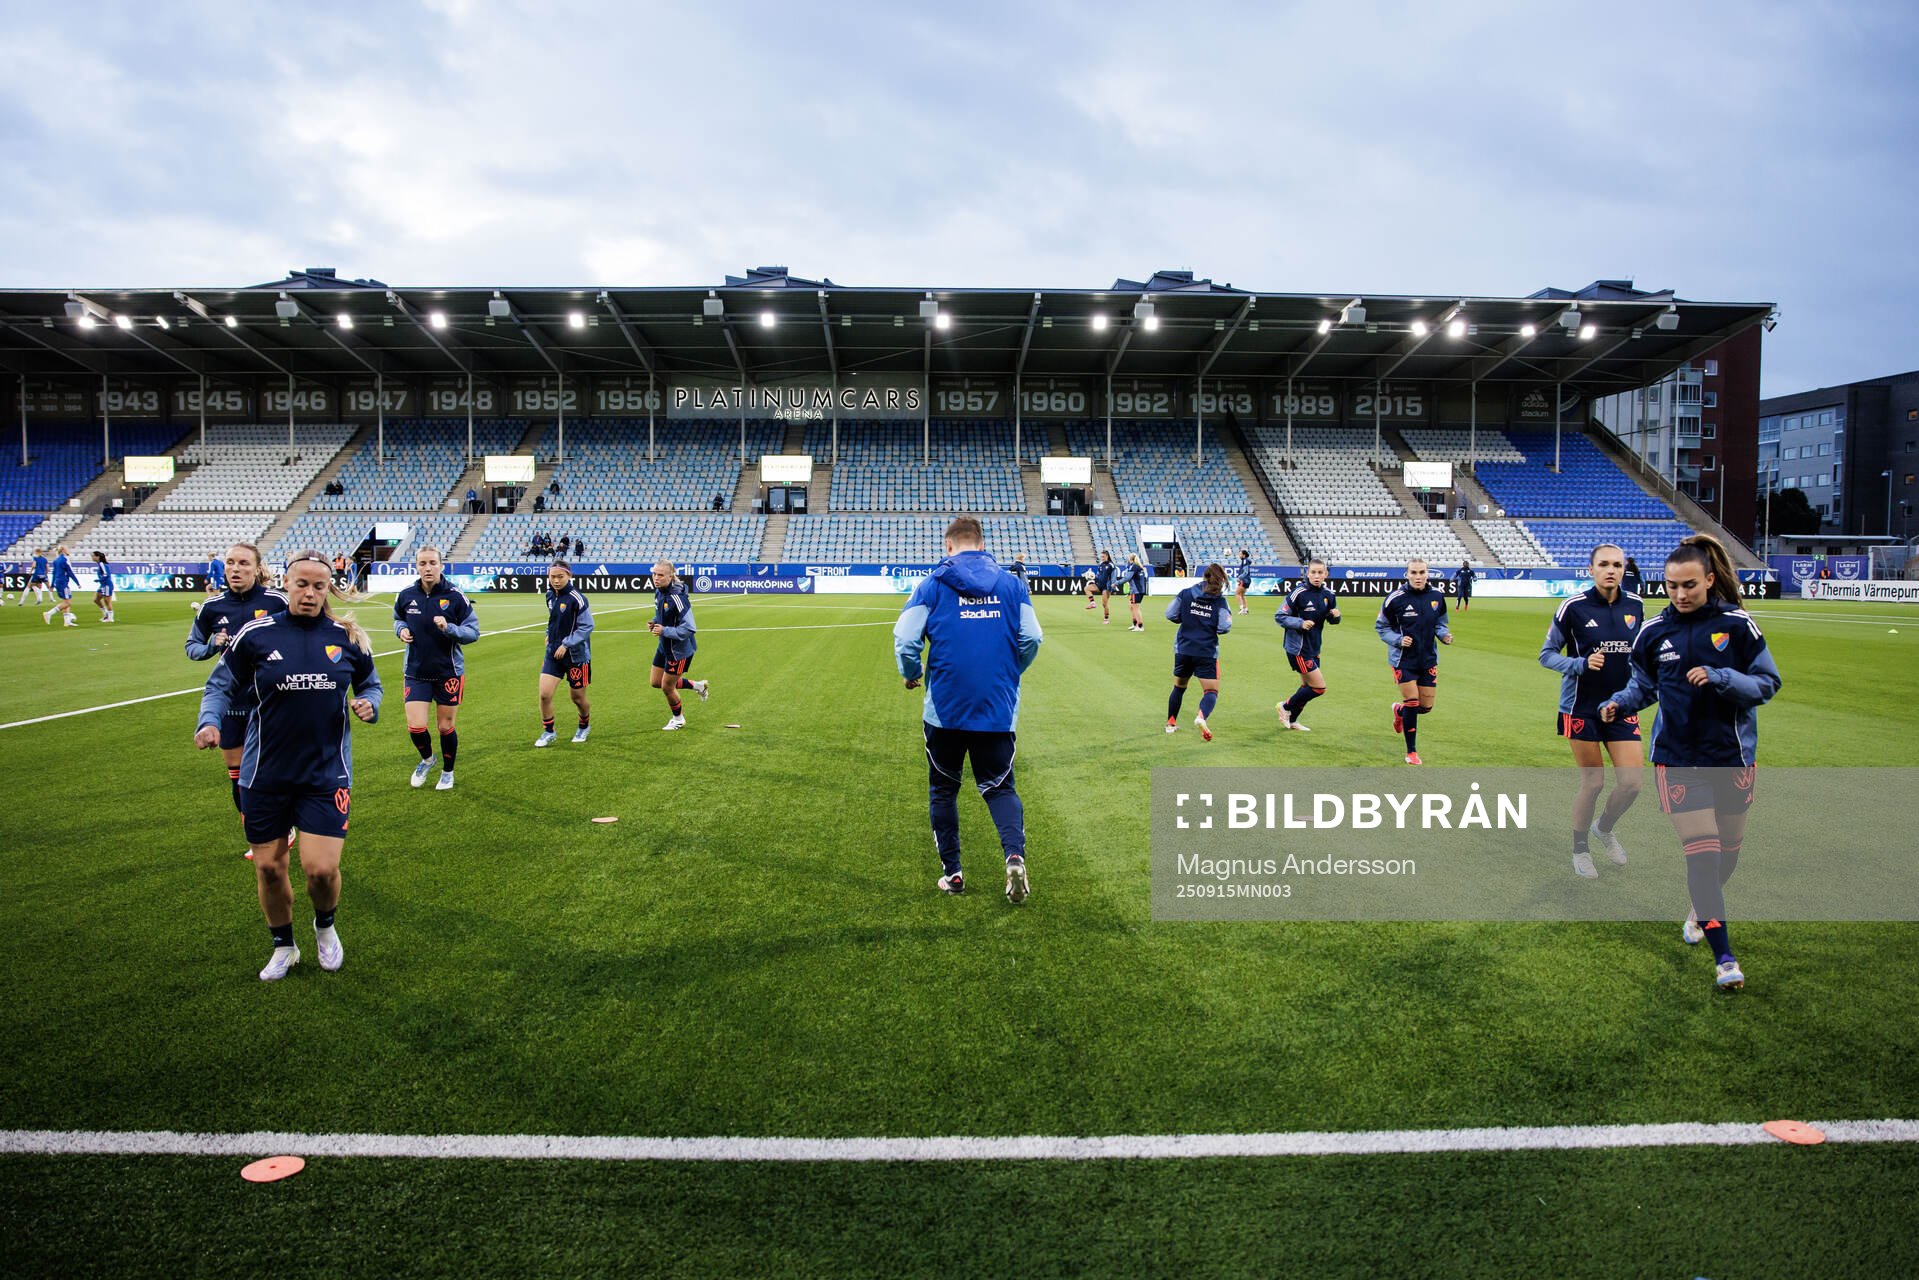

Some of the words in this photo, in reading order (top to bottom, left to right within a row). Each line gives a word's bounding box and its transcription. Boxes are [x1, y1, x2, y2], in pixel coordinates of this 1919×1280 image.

[96, 391, 158, 411] 1943
[174, 390, 242, 411] 1945
[264, 390, 326, 411] 1946
[347, 390, 408, 411] 1947
[429, 390, 493, 411] 1948
[513, 390, 577, 411] 1952
[596, 390, 661, 411] 1956
[674, 387, 921, 409] PLATINUMCARS
[936, 391, 999, 412] 1957
[1021, 391, 1085, 412] 1960
[1104, 392, 1169, 413] 1962
[1188, 393, 1253, 414] 1963
[1271, 393, 1335, 415] 1989
[1355, 394, 1423, 416] 2015
[774, 409, 823, 420] ARENA
[473, 566, 504, 575] EASY
[515, 566, 549, 576] COFF
[822, 566, 851, 576] FRONT
[714, 580, 730, 589] IFK
[732, 578, 794, 590] NORRKÖPING
[1821, 582, 1861, 597] Thermia
[960, 609, 1001, 619] stadium
[1593, 646, 1632, 654] WELLNESS
[276, 681, 337, 691] WELLNESS
[286, 673, 329, 682] NORDIC
